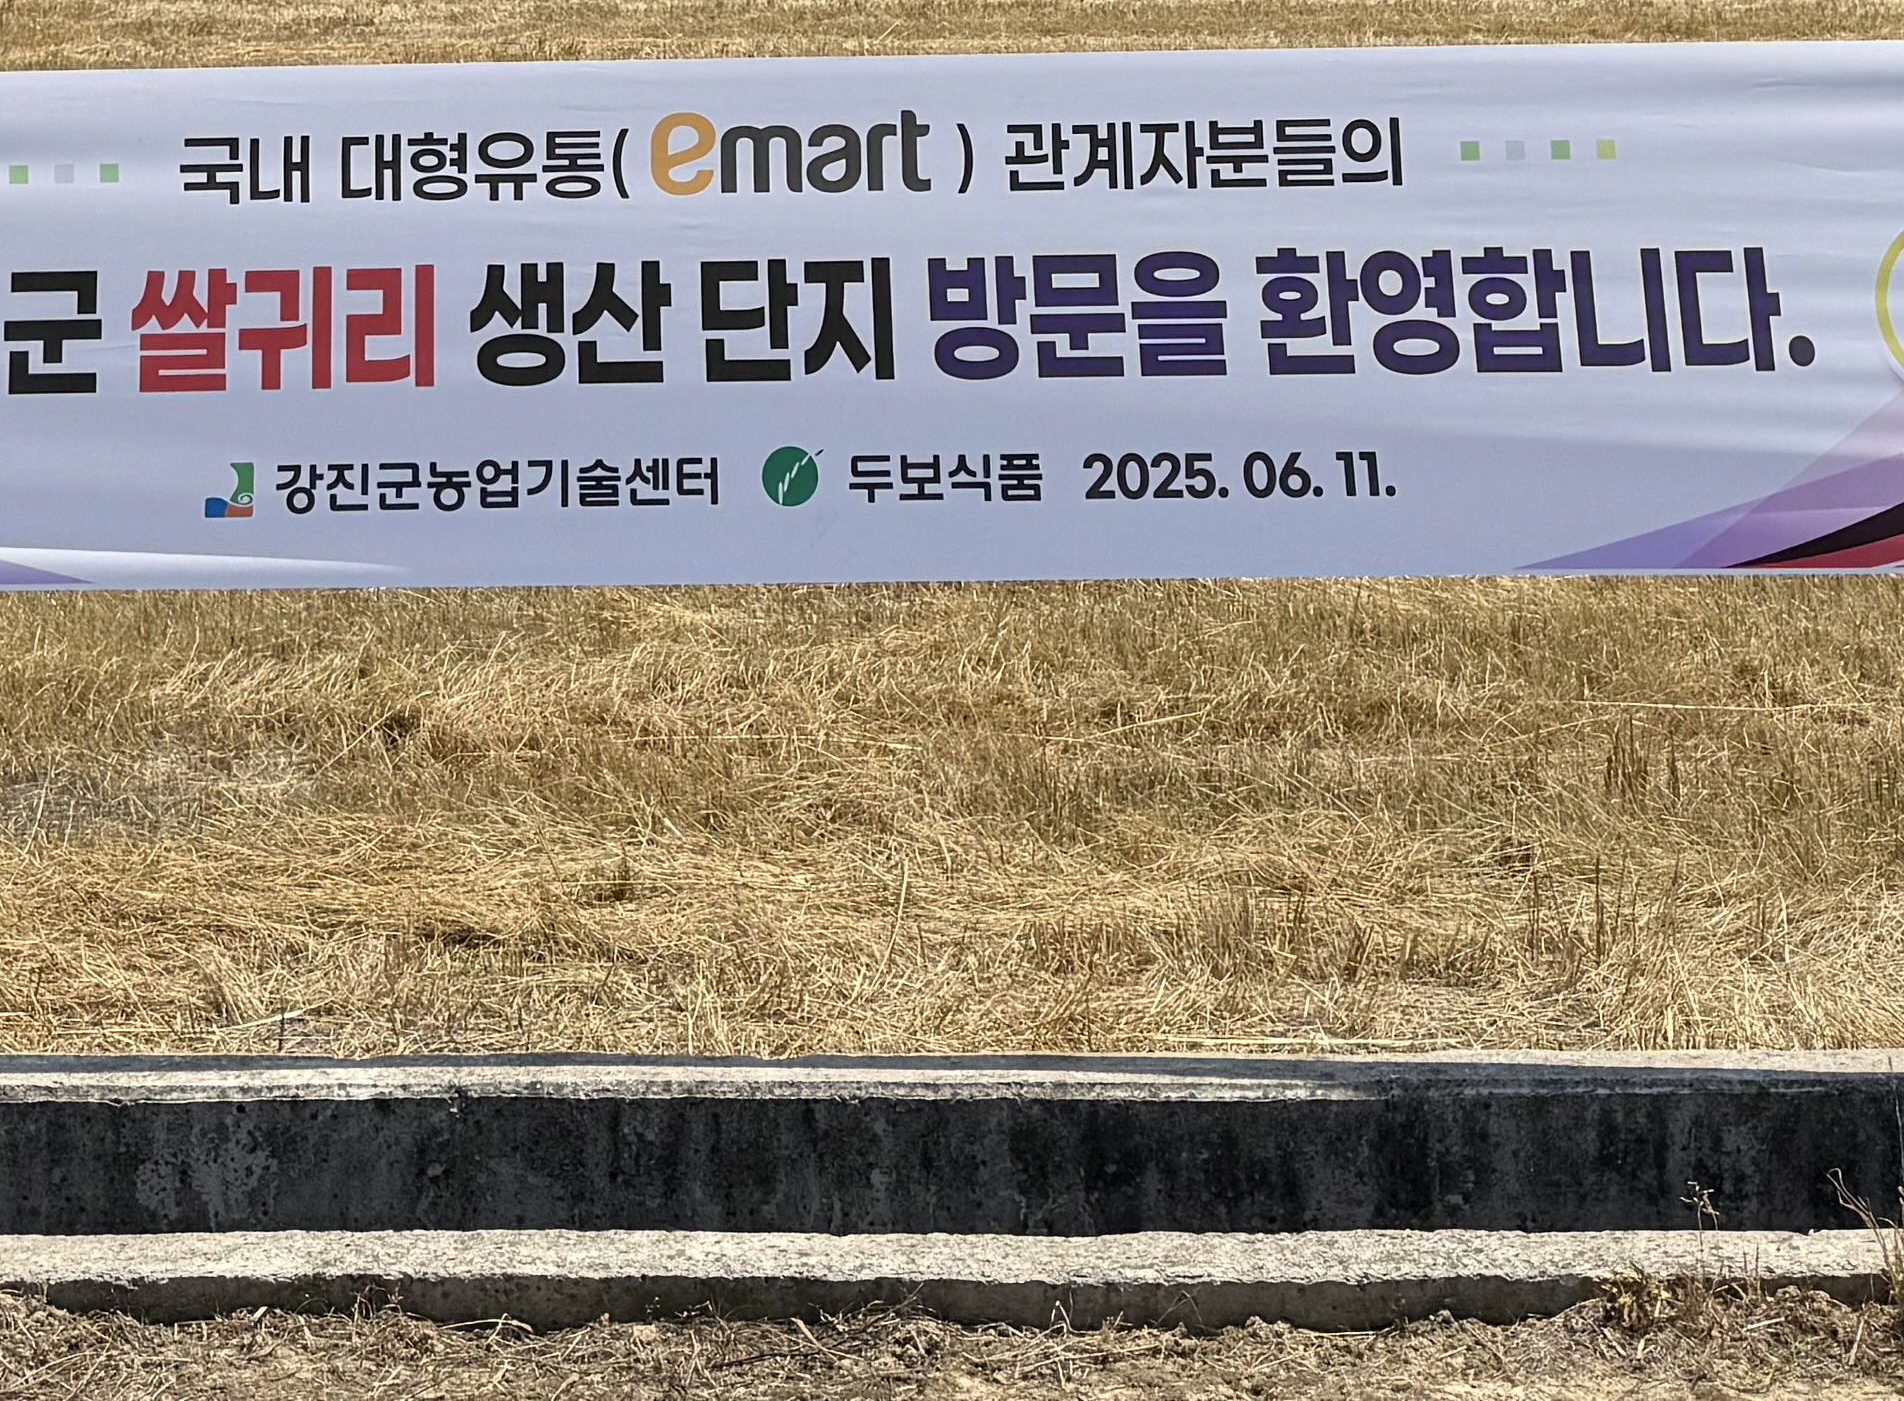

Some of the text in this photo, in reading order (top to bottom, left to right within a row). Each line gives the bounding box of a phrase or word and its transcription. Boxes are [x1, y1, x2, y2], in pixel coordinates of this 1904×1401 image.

[180, 136, 310, 204] 국내
[652, 110, 931, 194] emart
[1005, 117, 1402, 191] 관계자분들의
[132, 265, 434, 392] 쌀귀리
[470, 261, 671, 386] 생산
[701, 257, 895, 382] 단지
[928, 251, 1227, 380] 방문을
[1256, 247, 1815, 375] 환영합니다.
[276, 457, 718, 514] 강진군농업기술센터
[849, 453, 1042, 503] 두보식품
[1083, 451, 1396, 499] 2025. 06. 11.
